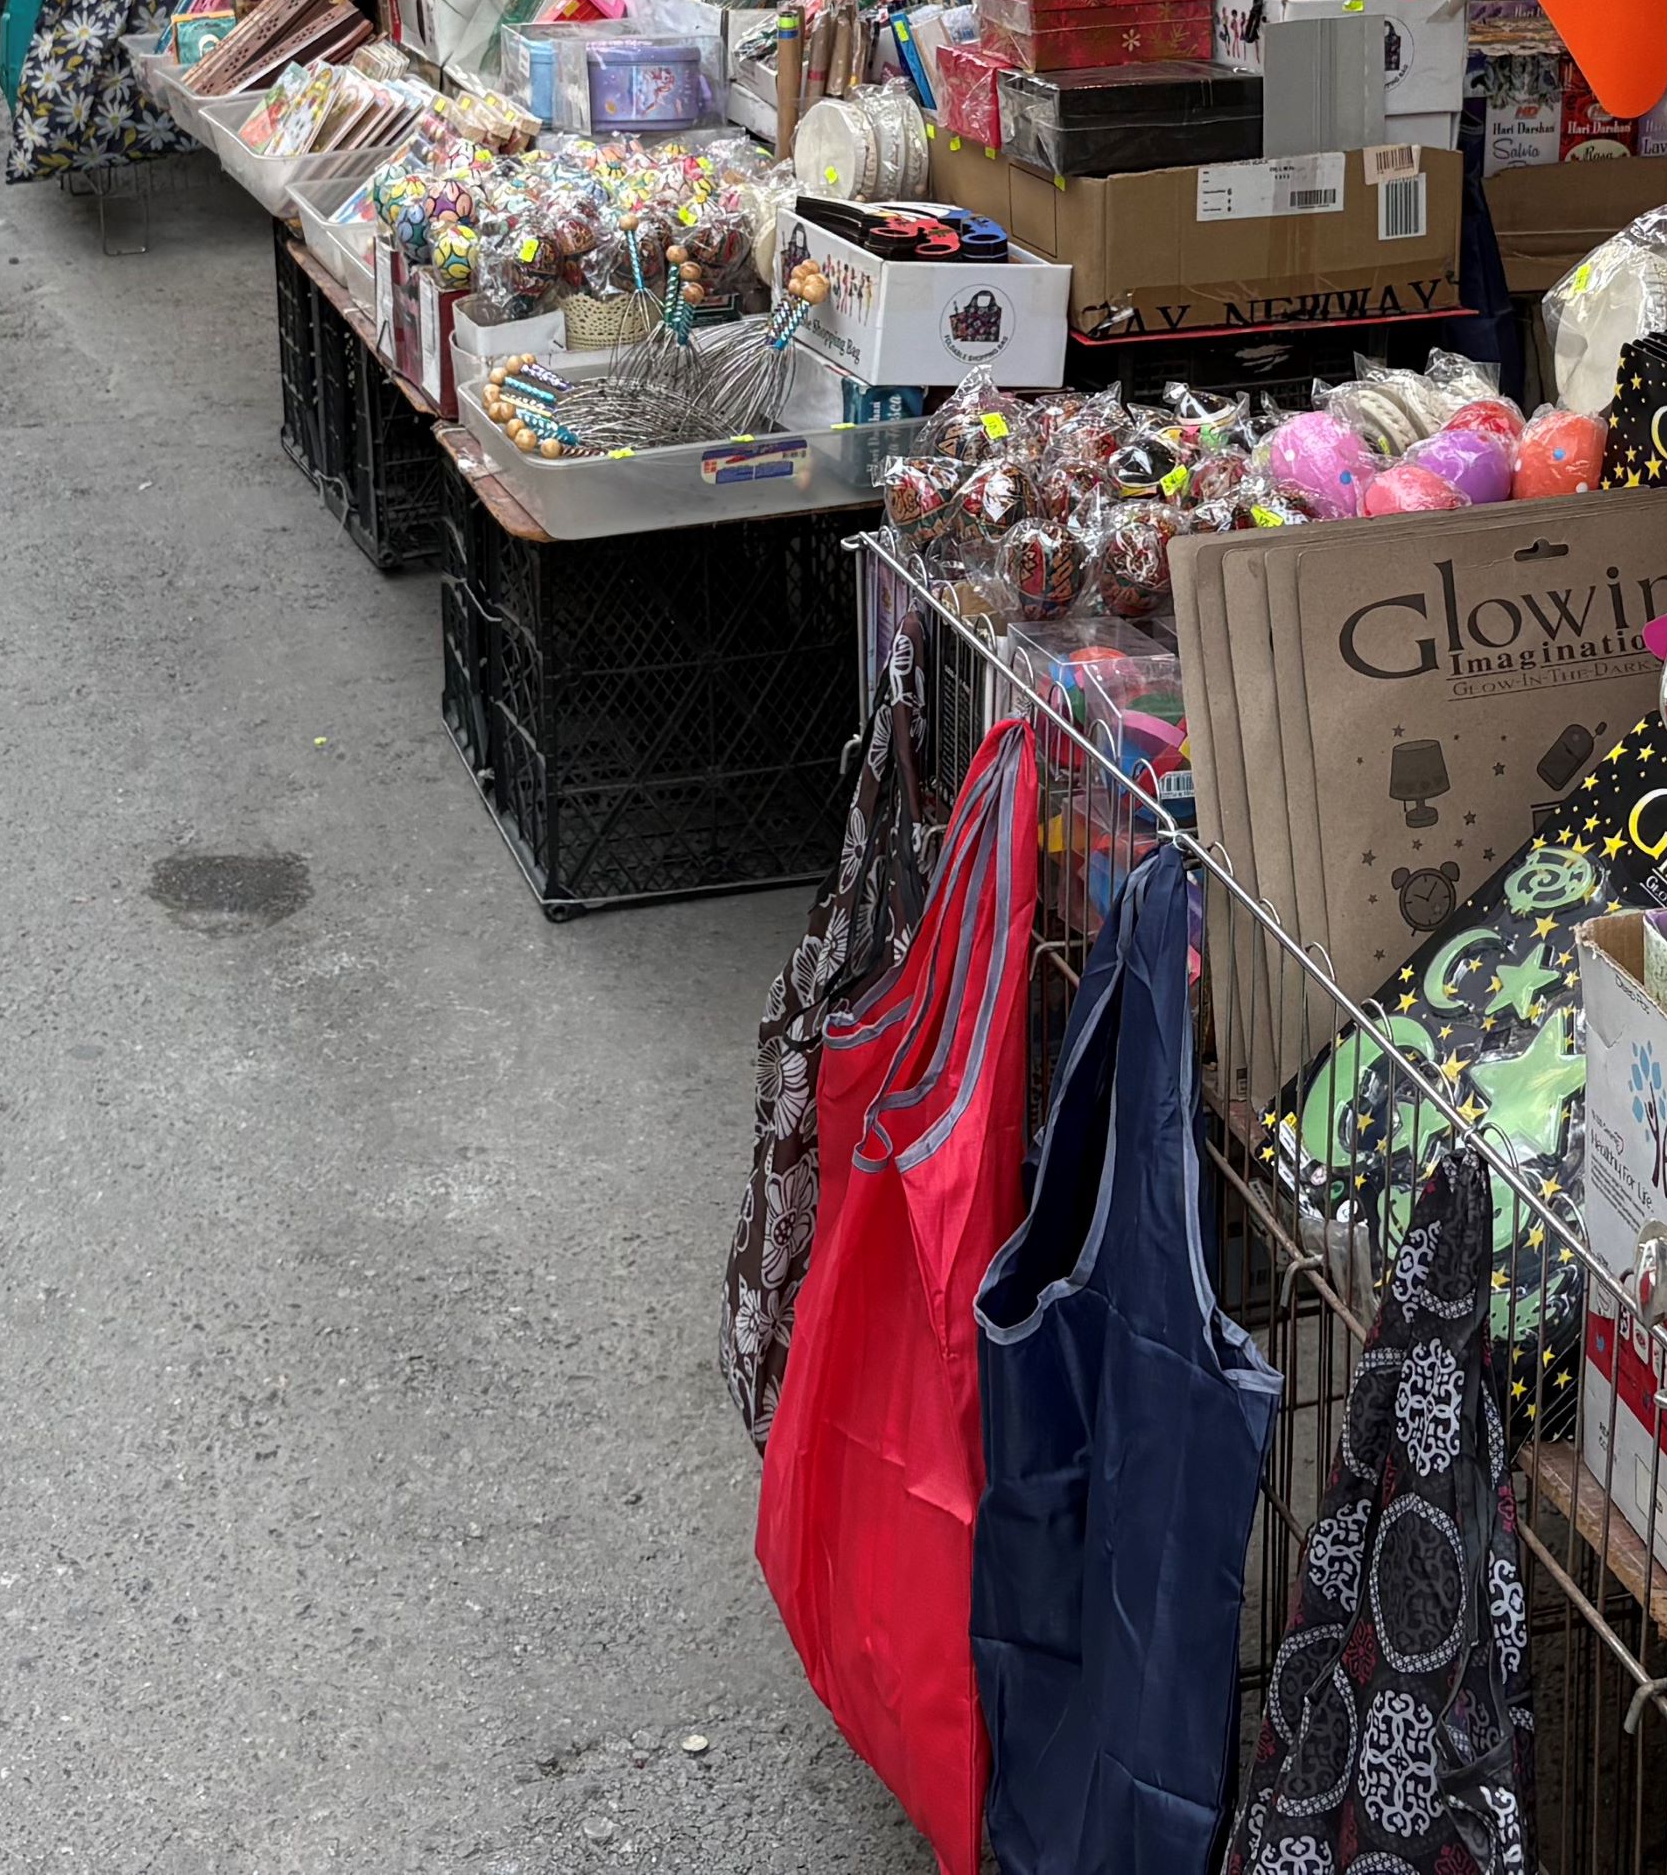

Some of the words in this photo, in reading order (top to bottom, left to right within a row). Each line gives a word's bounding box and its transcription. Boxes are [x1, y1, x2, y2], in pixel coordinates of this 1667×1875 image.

[1492, 121, 1514, 136] Hari
[1517, 120, 1554, 135] Darshan
[1567, 121, 1590, 134] Hari
[1592, 120, 1631, 135] Darshan
[1492, 138, 1540, 160] Salvia
[810, 317, 846, 359] Shopping
[846, 339, 861, 365] Bag
[943, 334, 968, 362] FOLDABLE
[968, 347, 998, 363] SHOPPING
